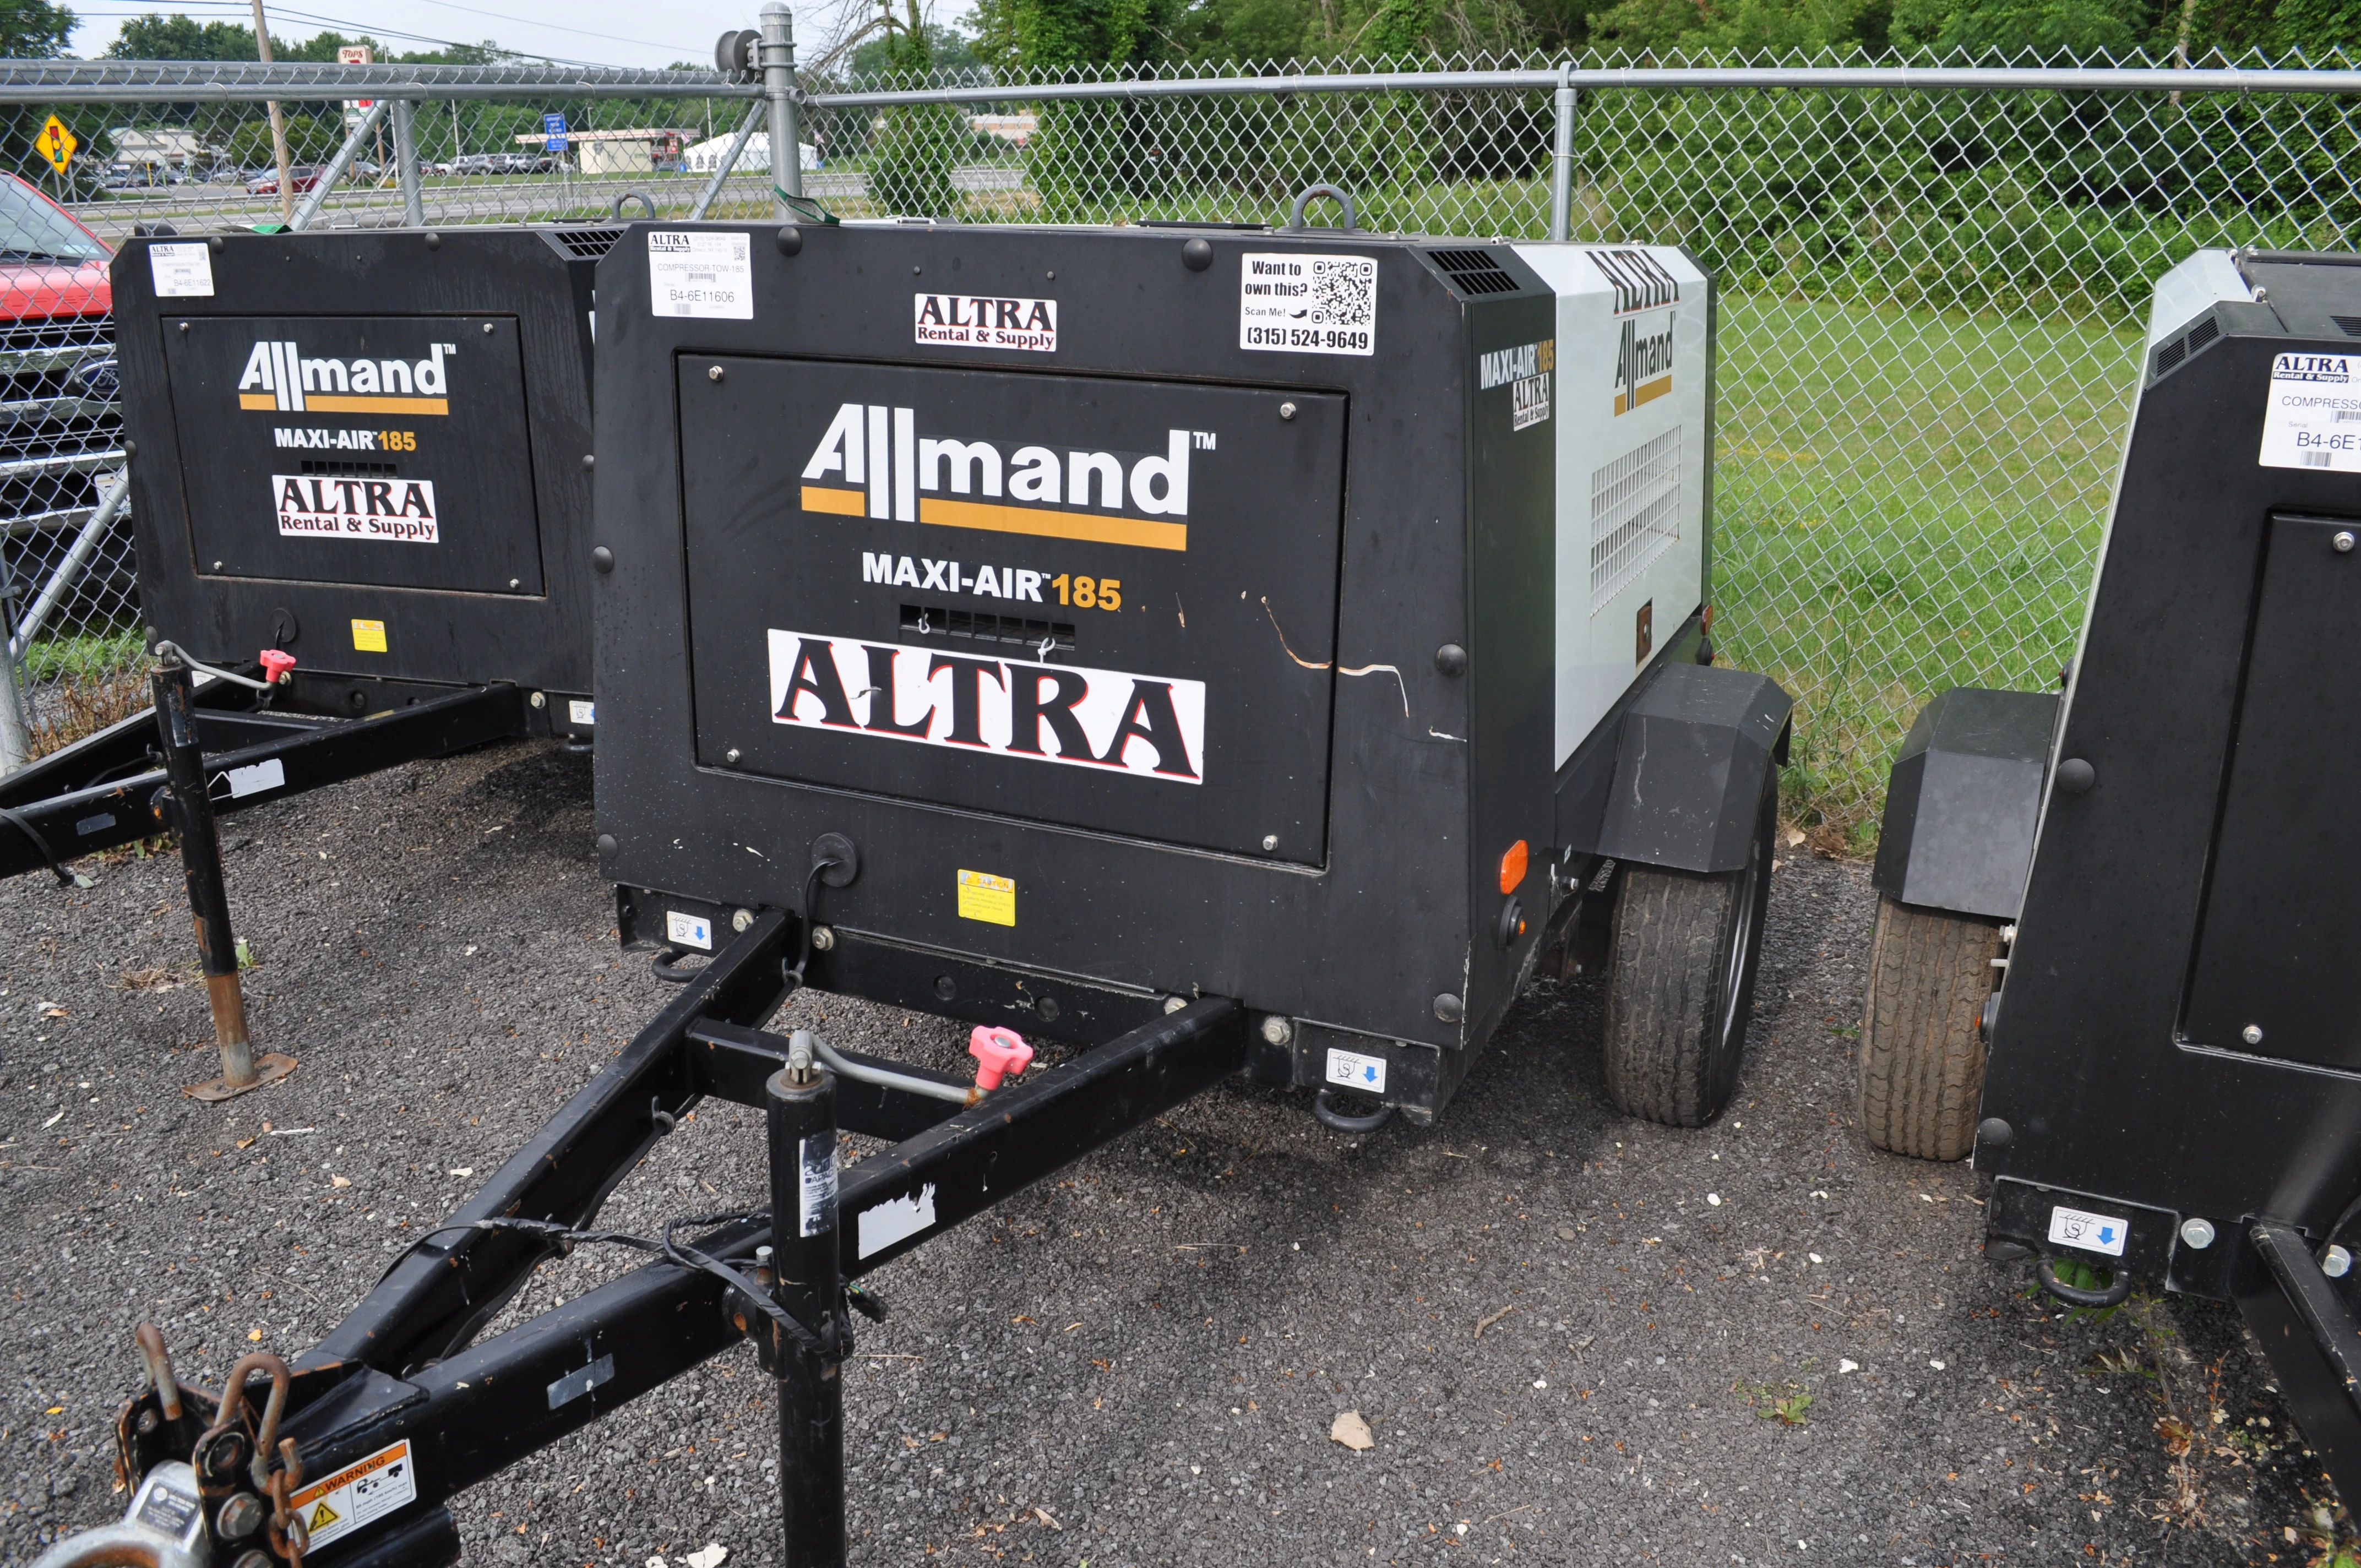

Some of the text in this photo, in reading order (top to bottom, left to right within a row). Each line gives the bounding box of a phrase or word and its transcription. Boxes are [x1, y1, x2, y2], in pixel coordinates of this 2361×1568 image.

[342, 50, 363, 58] TOPS
[650, 235, 689, 245] ALTRA
[657, 263, 744, 273] COMPRESSOR-TOW-185
[1252, 261, 1301, 276] Want to
[1245, 282, 1308, 296] own this?
[1584, 249, 1679, 315] ALTRA
[670, 290, 734, 302] B4-6E11606
[917, 296, 1054, 332] ALTRA
[1245, 307, 1286, 317] Scan Me!
[918, 326, 1054, 350] Rental & Supply
[1247, 327, 1368, 349] (315) 524-9649
[1481, 339, 1554, 390] MAXI-AIR 185
[1614, 311, 1673, 412] Allmand
[2275, 356, 2349, 373] ALTRA
[238, 341, 447, 411] Allmand
[2316, 374, 2349, 383] Supply
[1514, 374, 1548, 412] ALTRA
[1514, 404, 1548, 427] Rental & Supply
[274, 427, 417, 451] MAXI-AIR 185
[801, 403, 1190, 522] Allmand
[279, 478, 434, 519] ALTRA
[280, 514, 435, 540] Rental & Supply
[862, 552, 1044, 603] MAXI-AIR
[1051, 573, 1122, 612] 185
[775, 637, 1200, 780] ALTRA
[977, 878, 1009, 889] CAUTION
[805, 1169, 834, 1184] APAC
[325, 1456, 385, 1491] WARNING
